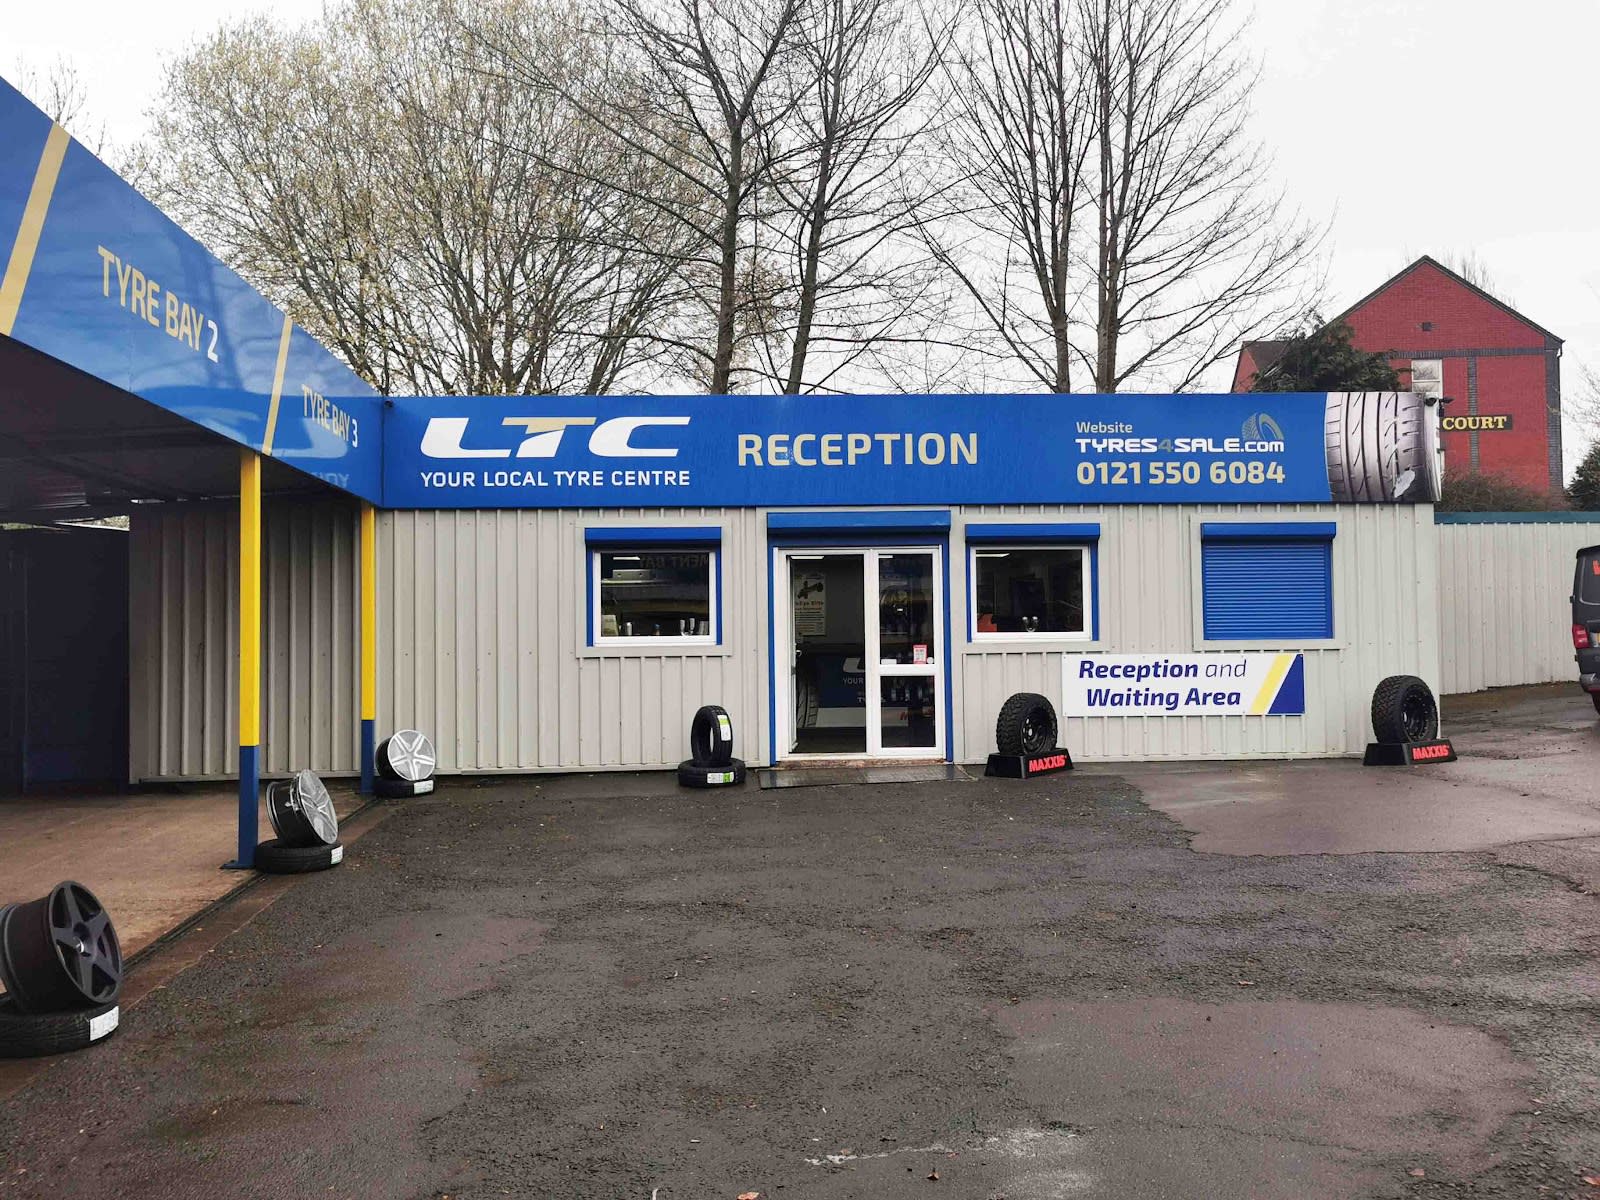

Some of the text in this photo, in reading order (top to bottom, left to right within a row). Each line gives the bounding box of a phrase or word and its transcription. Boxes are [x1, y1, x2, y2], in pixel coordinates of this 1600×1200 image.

[98, 245, 218, 363] TYRE BAY 2
[302, 384, 358, 448] TYRE BAY 3
[1076, 421, 1133, 433] Website
[1442, 416, 1507, 430] COURT
[420, 416, 691, 458] LTC
[738, 433, 978, 466] RECEPTION
[421, 470, 690, 487] YOUR LOCAL TYRE CENTRE
[1076, 461, 1286, 485] 0121 550 6084
[1079, 659, 1247, 682] Reception and
[1087, 687, 1241, 710] Waiting Area
[1029, 755, 1066, 772] MAXXIS
[1413, 745, 1449, 760] MAXXIS
